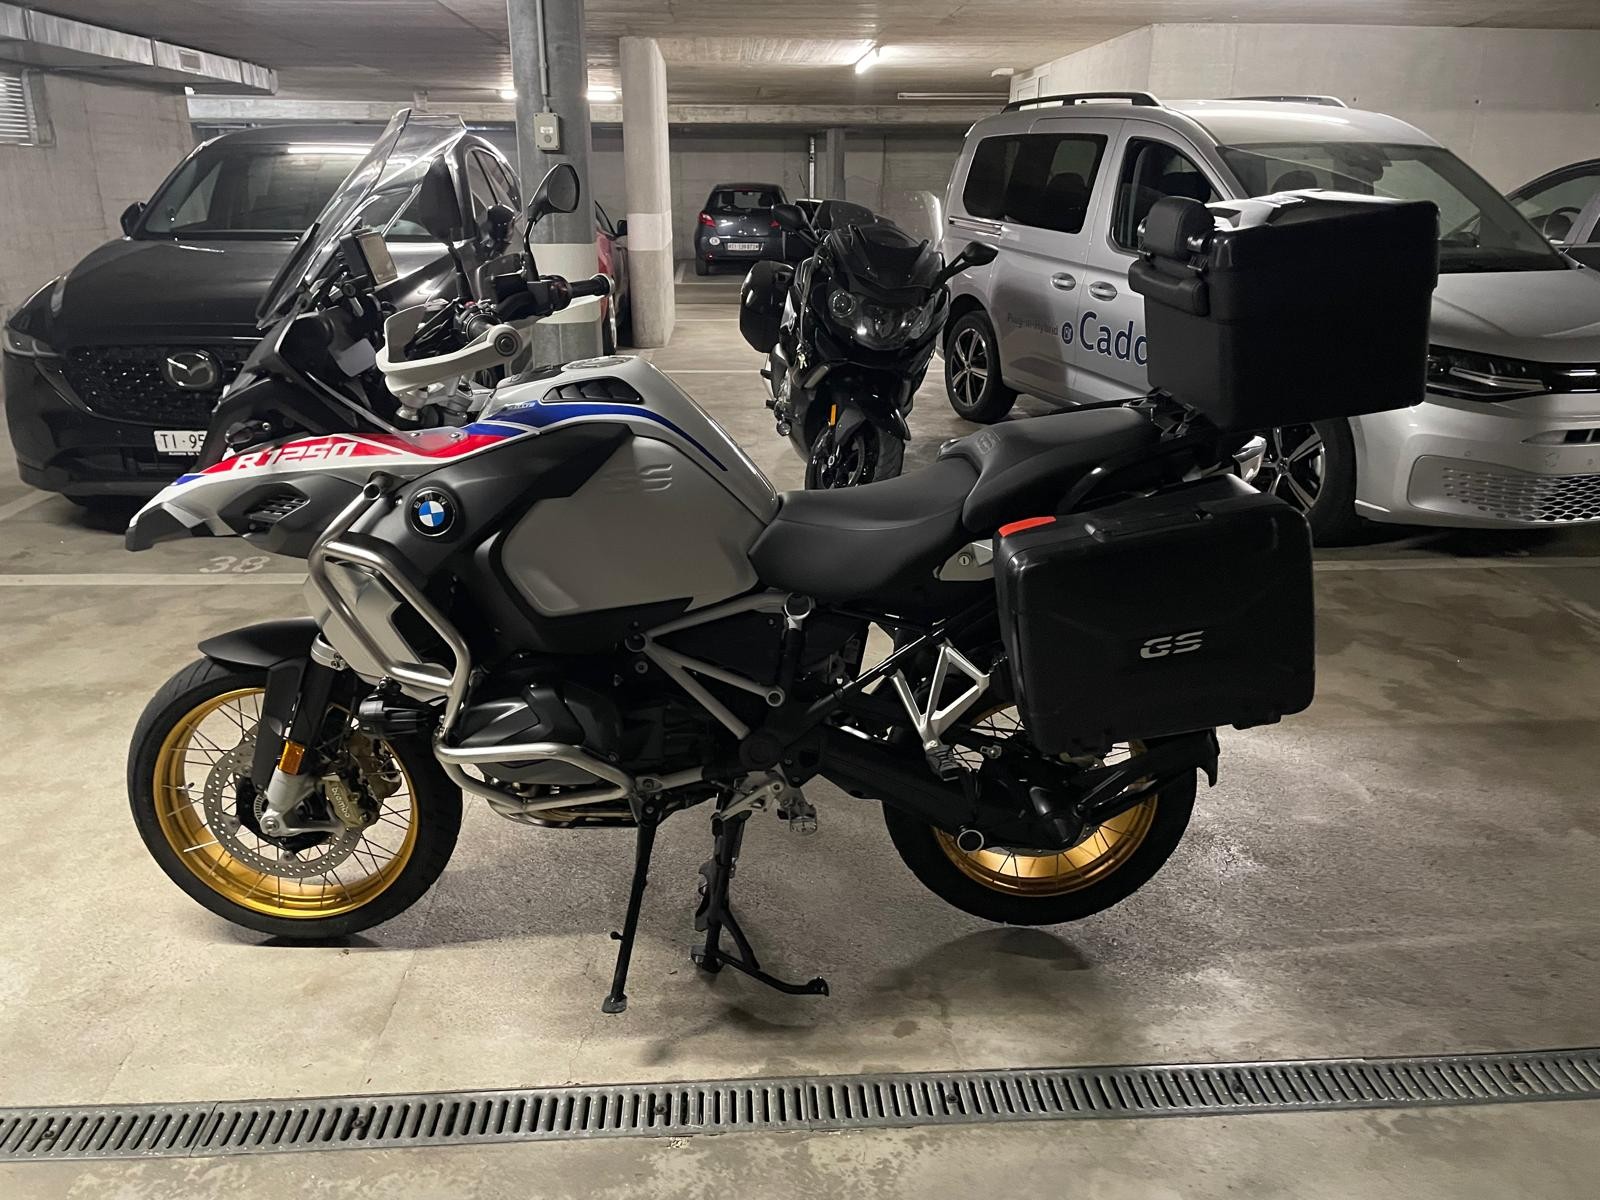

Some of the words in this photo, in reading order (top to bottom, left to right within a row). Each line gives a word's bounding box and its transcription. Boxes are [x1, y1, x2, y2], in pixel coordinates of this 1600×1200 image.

[199, 555, 271, 573] 38
[1140, 630, 1205, 659] GS
[331, 785, 350, 818] brembo
